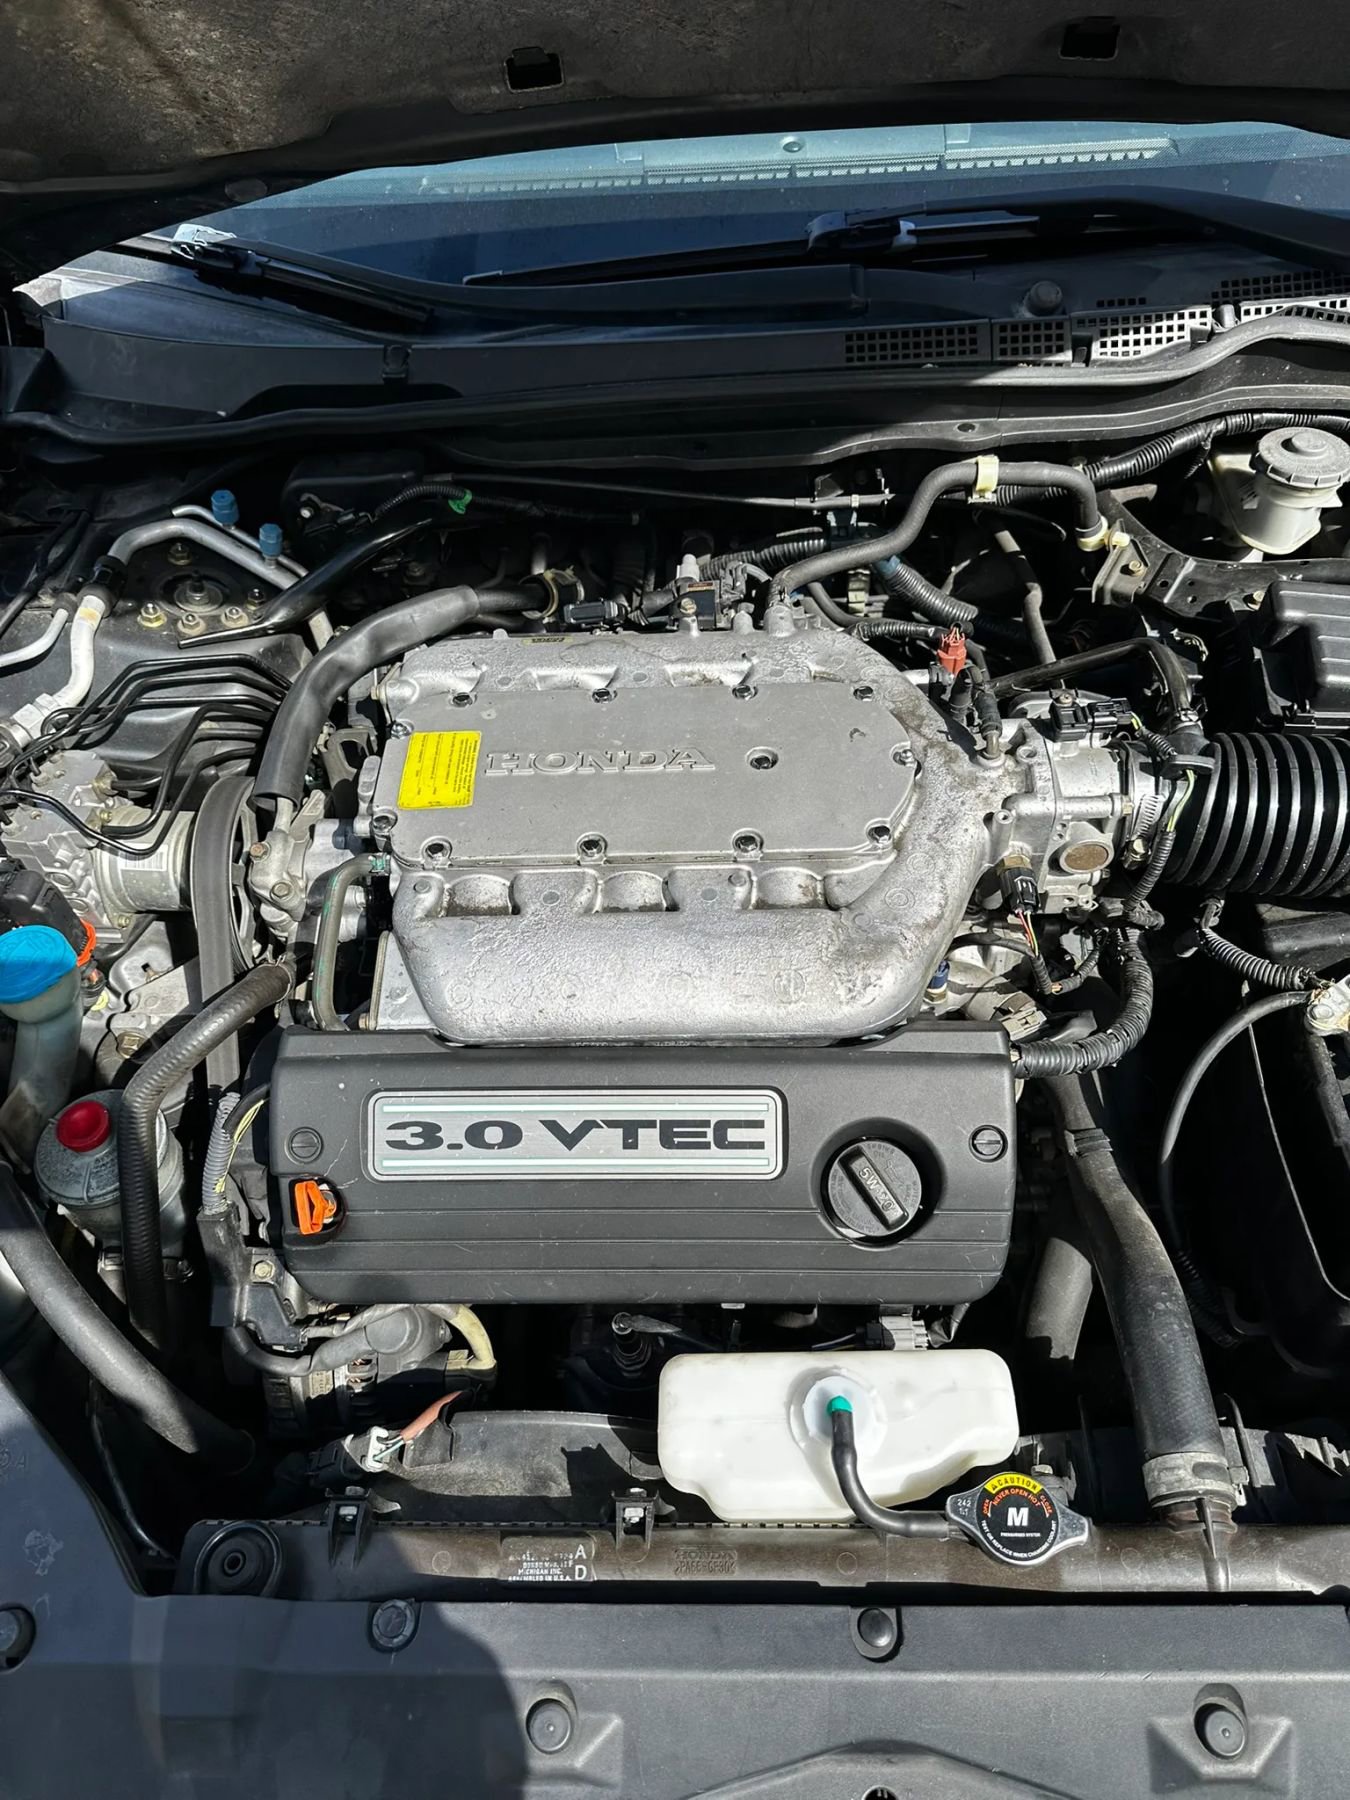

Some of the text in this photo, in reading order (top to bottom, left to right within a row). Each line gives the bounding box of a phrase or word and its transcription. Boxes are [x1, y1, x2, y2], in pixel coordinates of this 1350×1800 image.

[485, 748, 716, 776] HONDA
[385, 1118, 766, 1151] 3.0 VTEC
[997, 1476, 1039, 1491] CAUTION
[992, 1487, 1042, 1507] NEVER OPEN HOT
[1007, 1507, 1030, 1527] M
[574, 1543, 587, 1559] A
[574, 1564, 587, 1581] D
